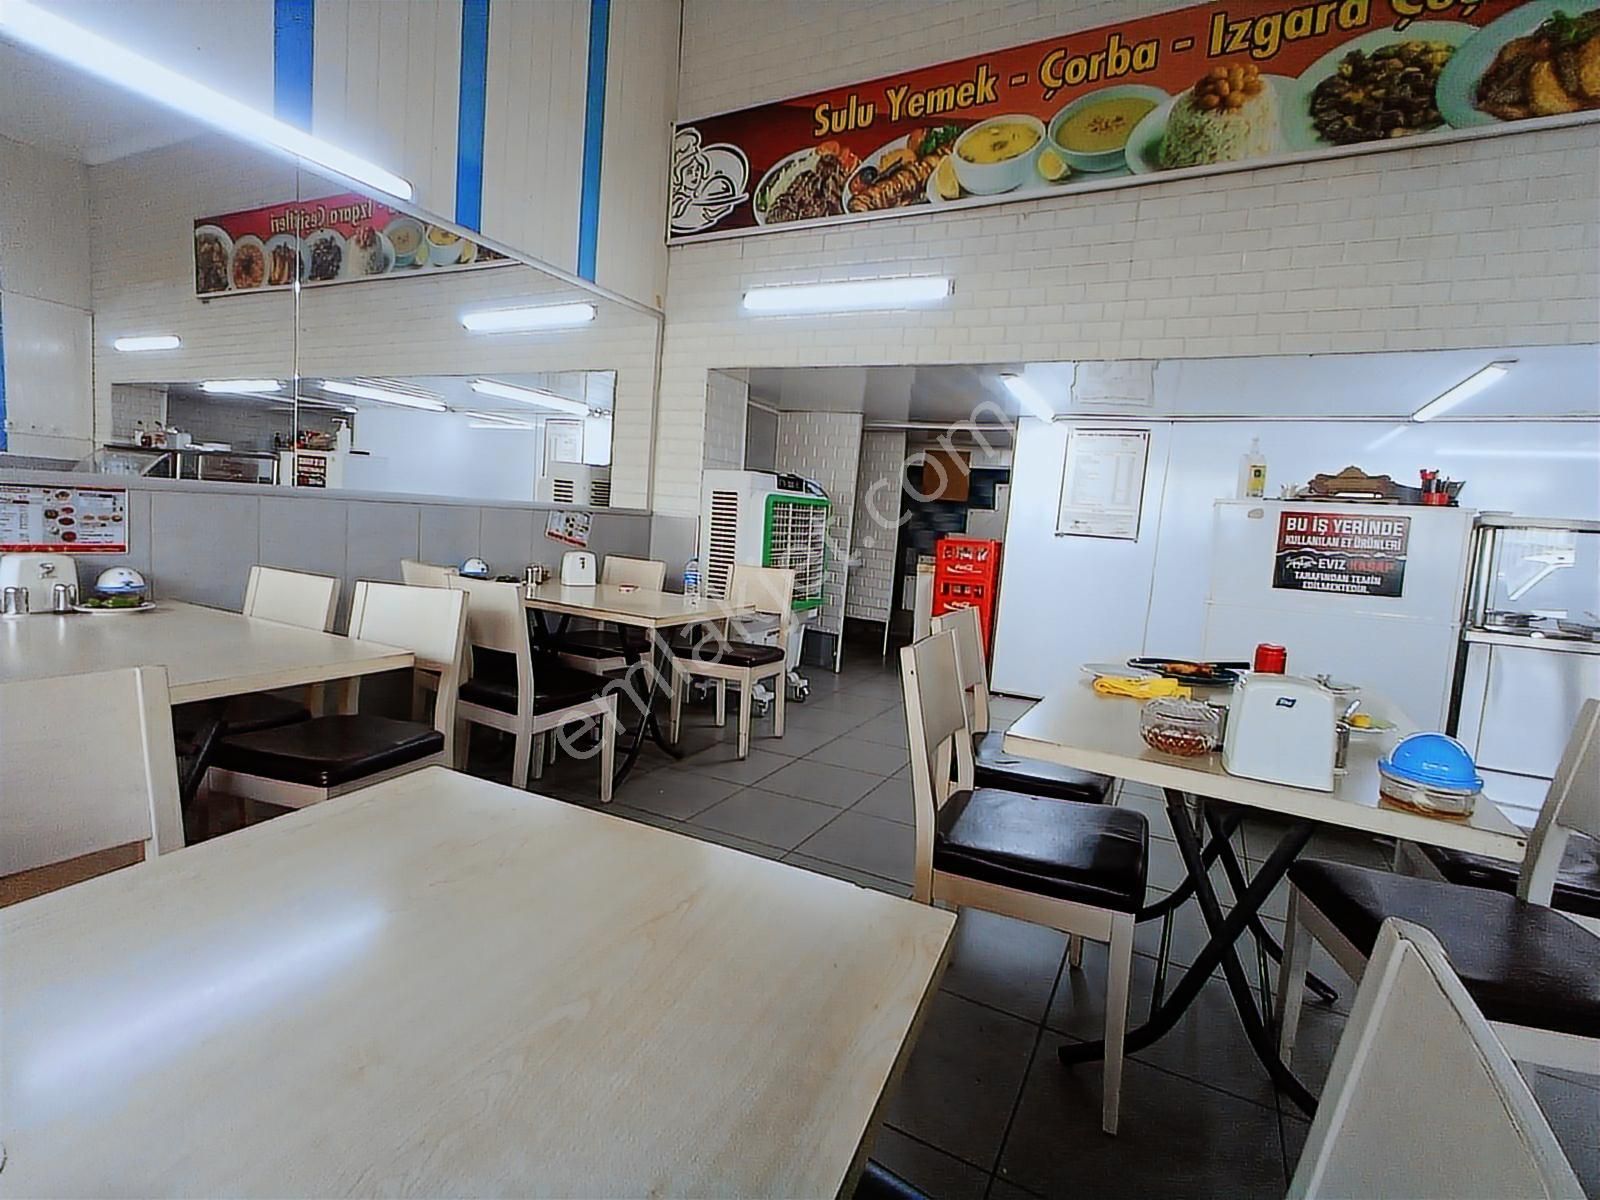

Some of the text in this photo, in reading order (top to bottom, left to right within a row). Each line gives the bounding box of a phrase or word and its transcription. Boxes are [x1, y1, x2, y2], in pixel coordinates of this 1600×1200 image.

[813, 101, 875, 136] Sulu
[886, 65, 999, 122] Yemek
[1040, 37, 1158, 101] Çorba
[1209, 0, 1370, 58] Izgara
[1286, 515, 1405, 537] BU İŞ YERİNDE
